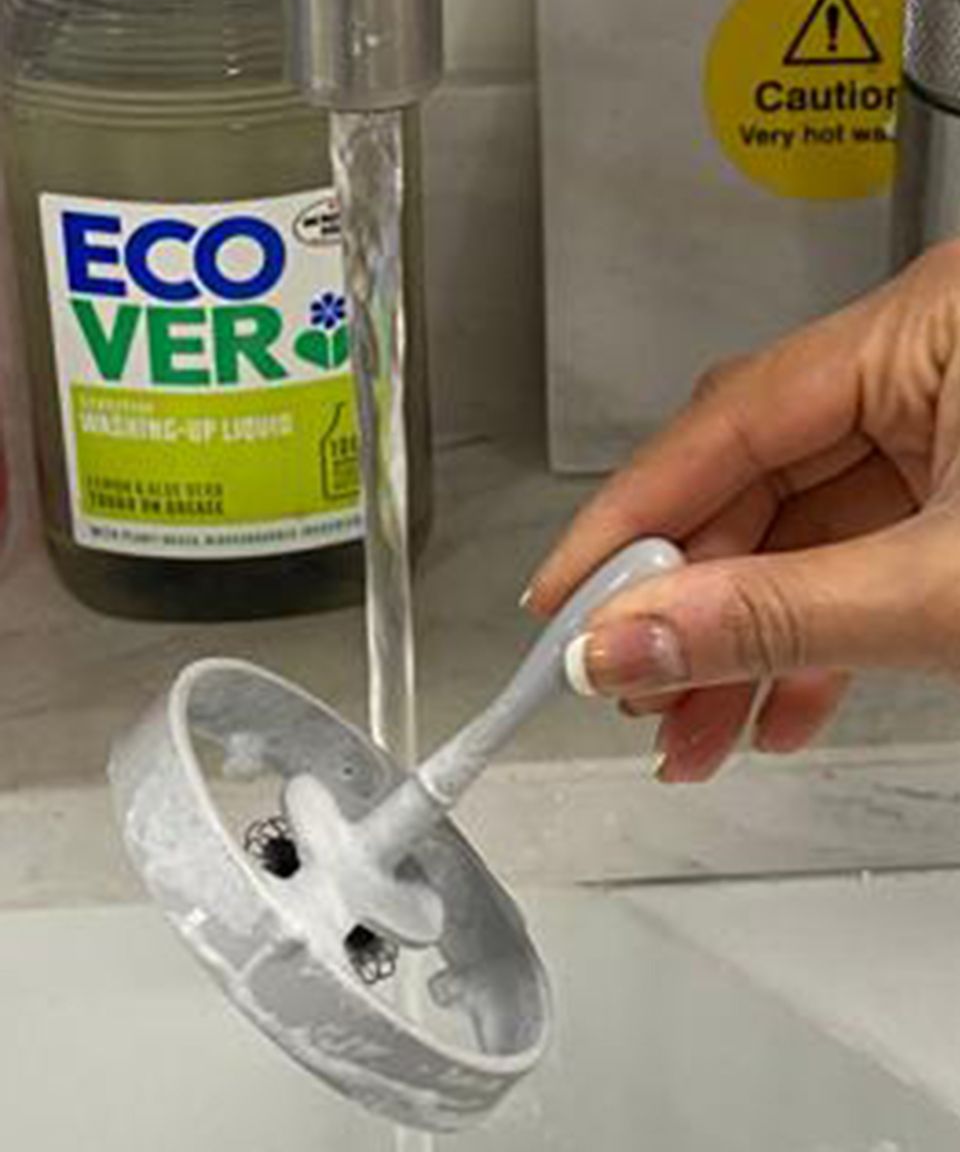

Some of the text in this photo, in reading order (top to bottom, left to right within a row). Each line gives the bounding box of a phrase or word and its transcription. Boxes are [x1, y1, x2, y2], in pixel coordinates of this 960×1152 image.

[740, 123, 795, 148] Very
[804, 124, 844, 142] hot
[61, 211, 286, 301] ECO
[70, 299, 288, 386] VER
